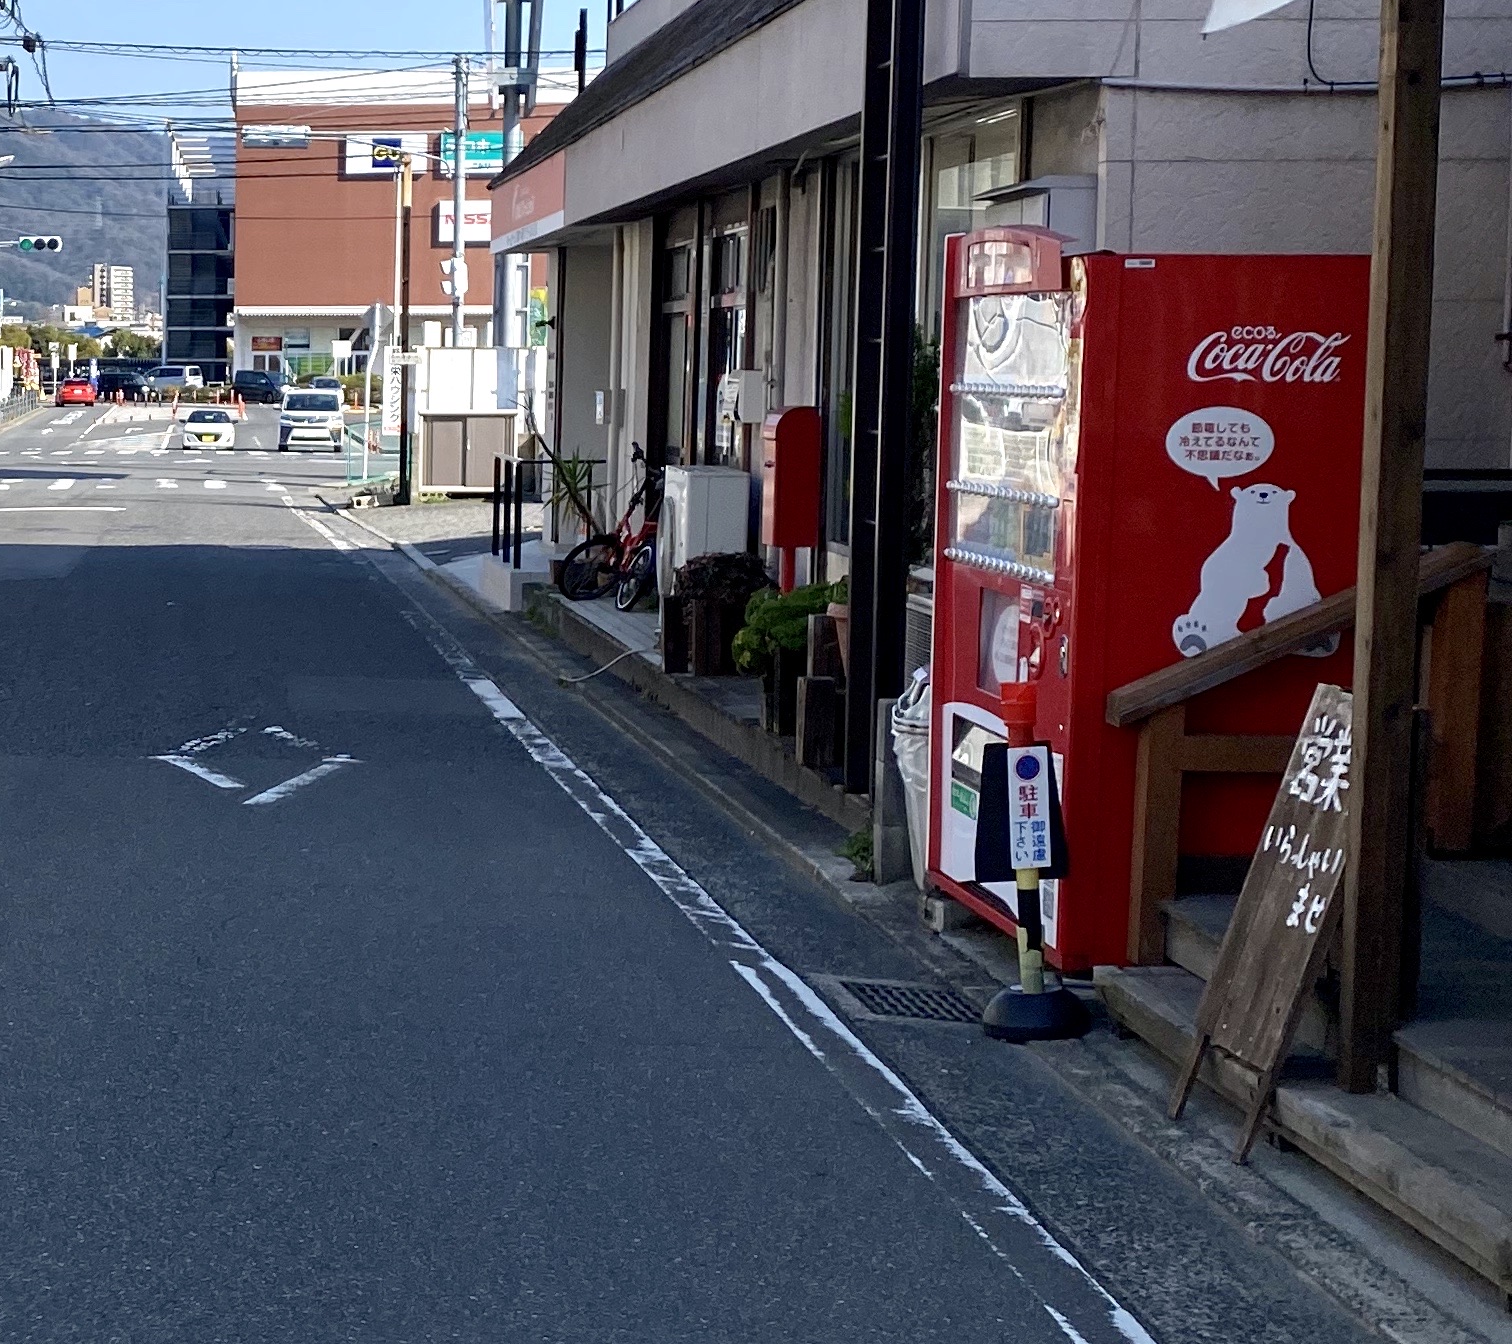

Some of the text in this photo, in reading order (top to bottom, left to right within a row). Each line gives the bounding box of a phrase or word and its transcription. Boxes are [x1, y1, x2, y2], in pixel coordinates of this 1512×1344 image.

[444, 213, 492, 225] NSS
[1179, 436, 1261, 448] 冷えてるなんて
[1191, 422, 1251, 434] 節電しても
[1018, 784, 1040, 820] 駐車
[1013, 821, 1029, 862] 下さい
[1031, 820, 1047, 862] 御遠慮
[1286, 882, 1326, 934] ませ
